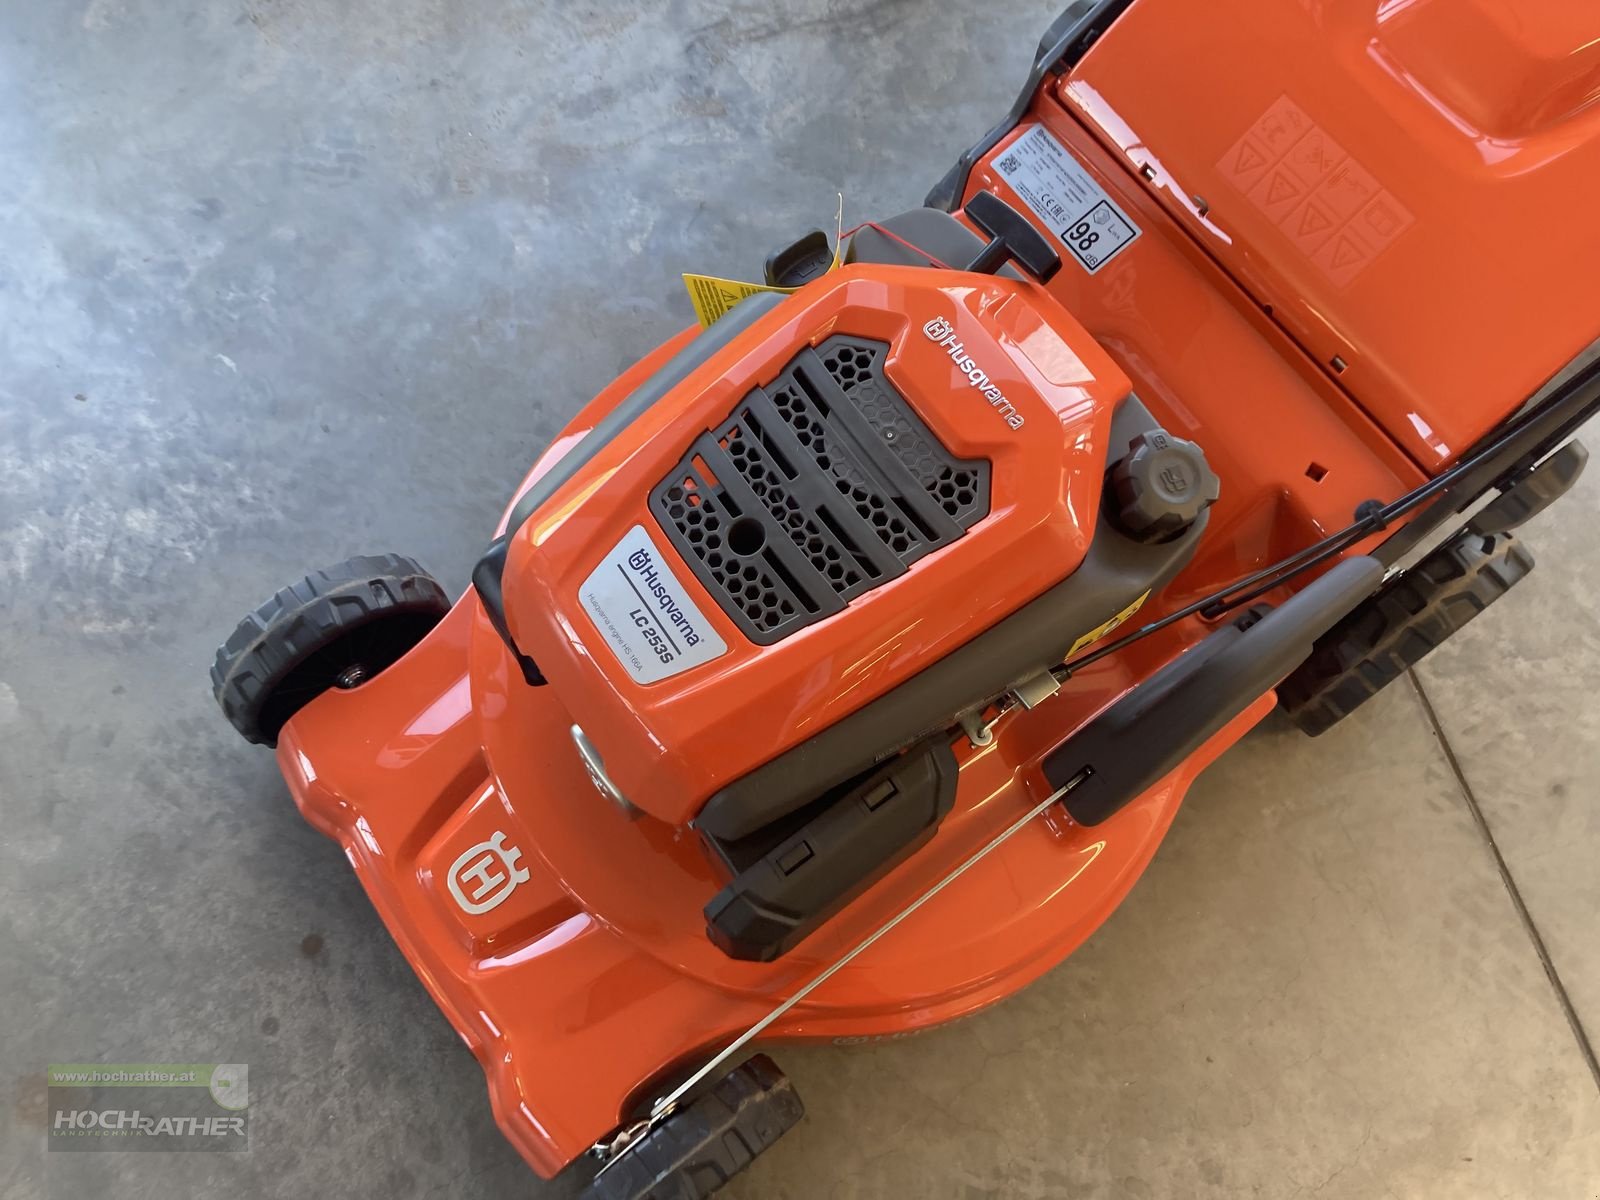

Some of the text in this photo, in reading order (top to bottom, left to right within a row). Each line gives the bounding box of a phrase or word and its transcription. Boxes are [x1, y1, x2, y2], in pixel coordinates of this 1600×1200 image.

[1069, 222, 1100, 251] 98
[1084, 253, 1099, 266] dB
[939, 334, 1025, 430] Husqvarna
[587, 593, 611, 626] Husqvarna
[608, 624, 623, 645] engine
[621, 642, 632, 654] HS
[639, 565, 700, 647] Husqvarna
[629, 609, 674, 664] LC 253S
